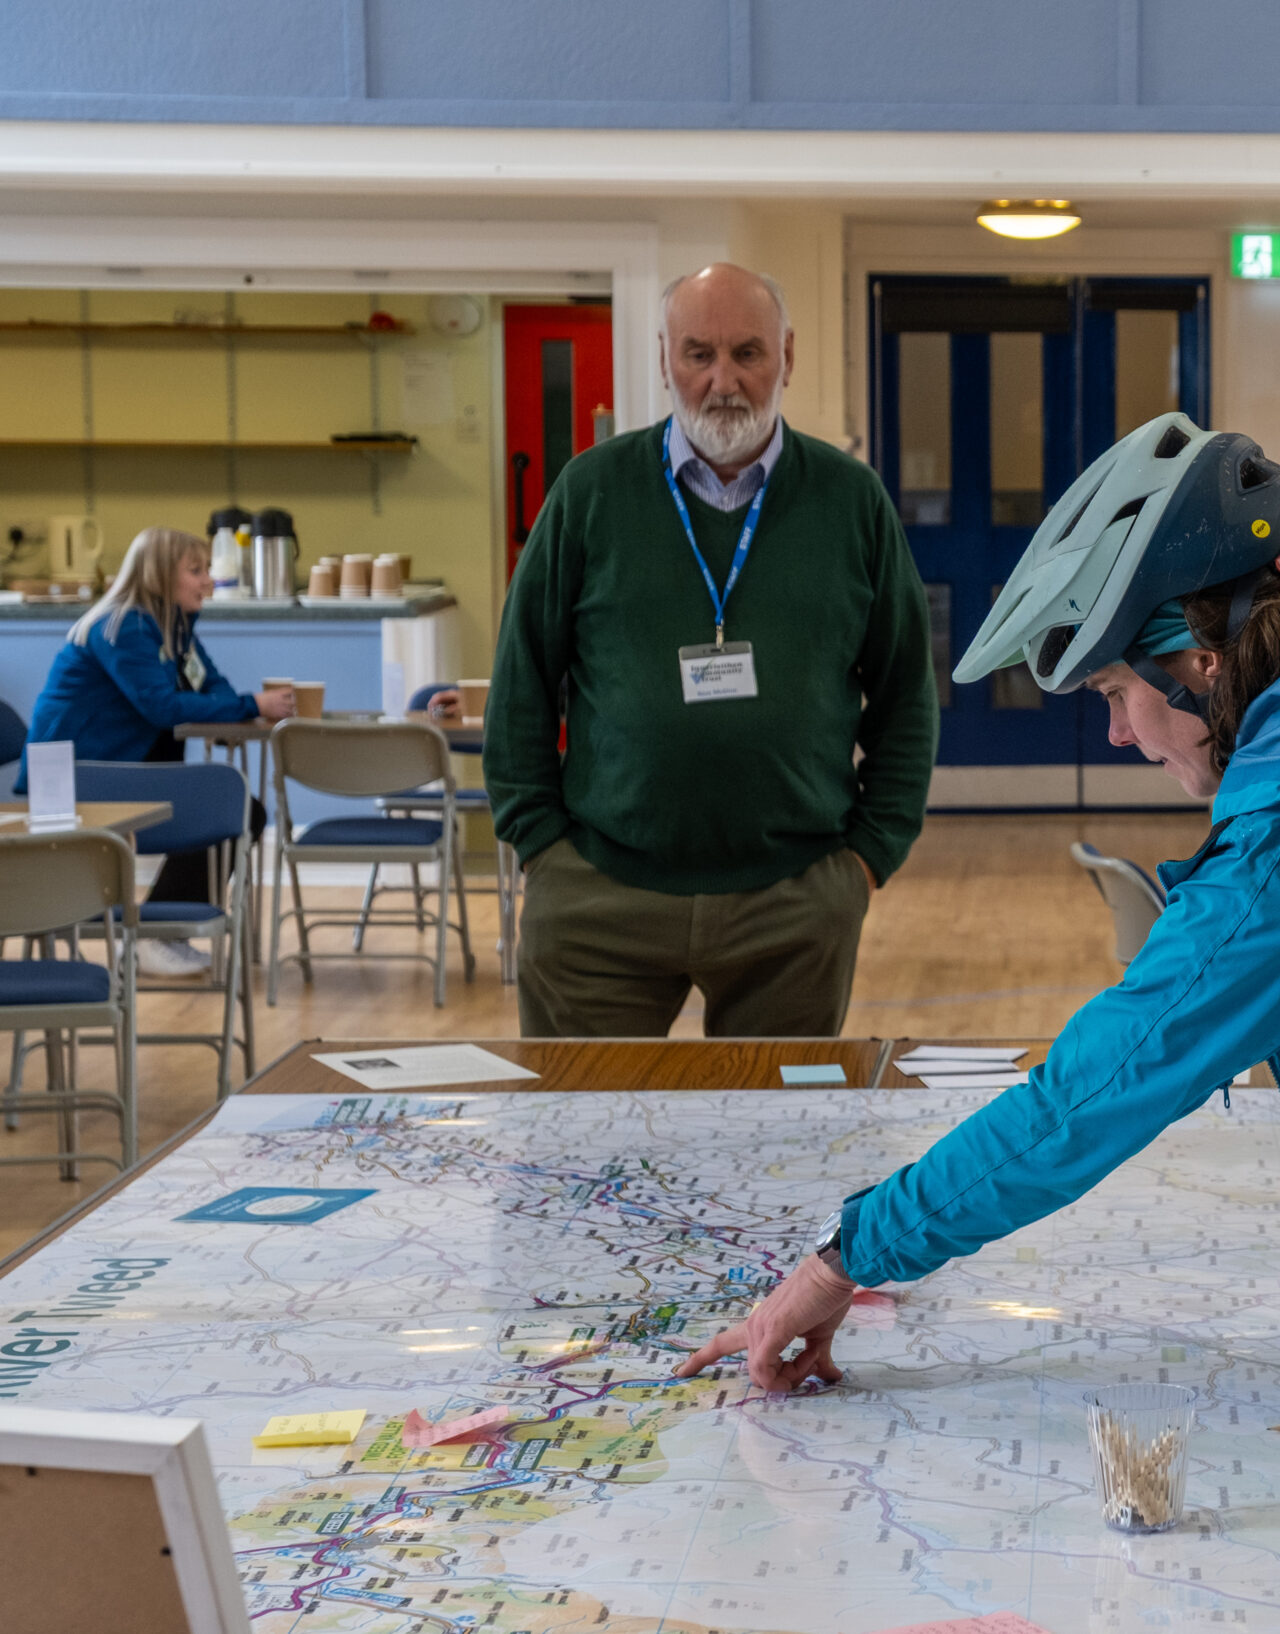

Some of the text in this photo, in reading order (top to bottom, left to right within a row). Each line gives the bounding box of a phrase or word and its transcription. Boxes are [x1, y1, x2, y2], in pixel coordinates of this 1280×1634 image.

[739, 526, 752, 550] STAFF
[0, 1257, 172, 1398] ver Tweed
